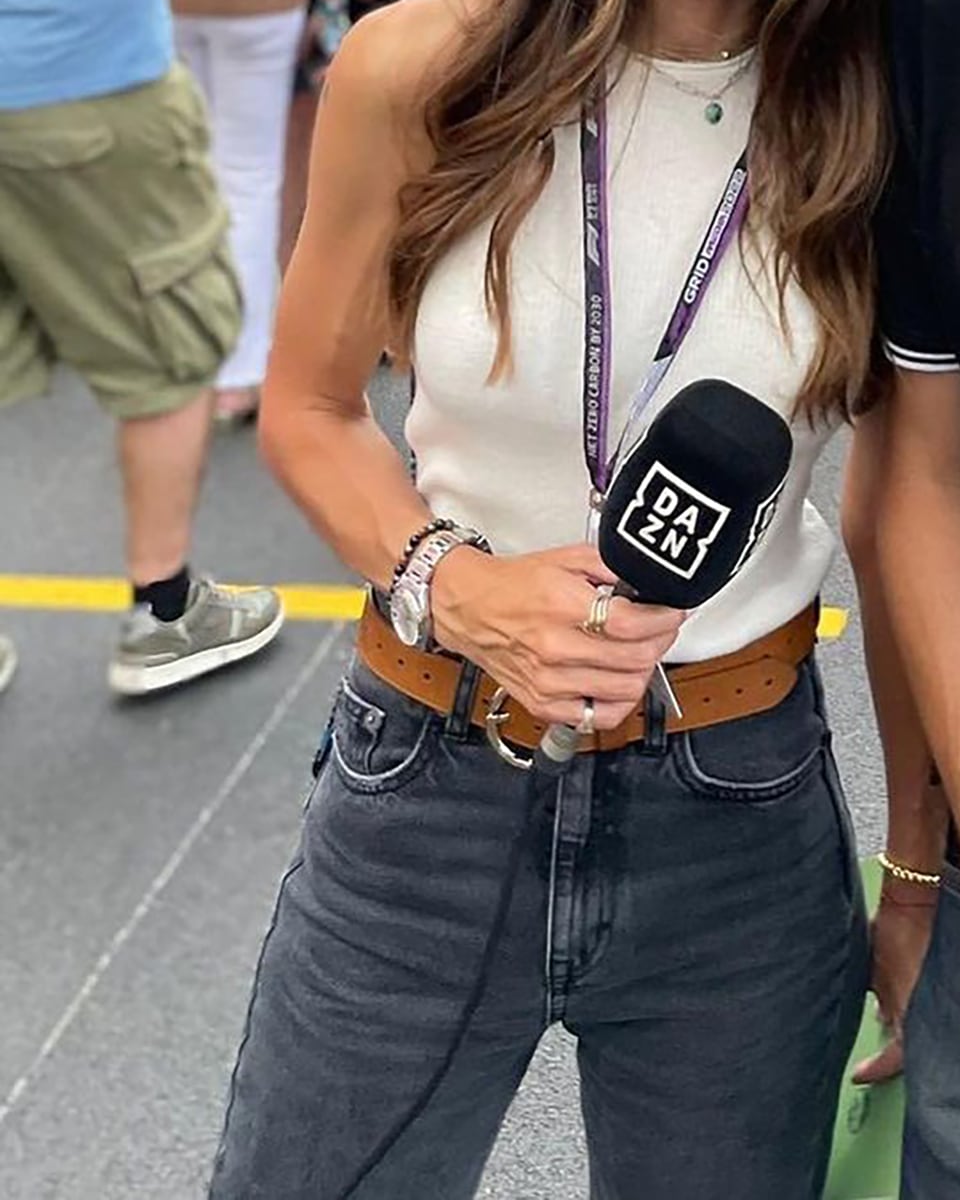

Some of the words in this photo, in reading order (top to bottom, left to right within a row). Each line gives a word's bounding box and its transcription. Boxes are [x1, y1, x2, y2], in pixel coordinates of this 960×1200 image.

[684, 257, 711, 304] GRID
[590, 294, 603, 326] 2030
[590, 327, 602, 347] BY
[588, 346, 602, 399] CARBON
[587, 401, 600, 432] ZERO
